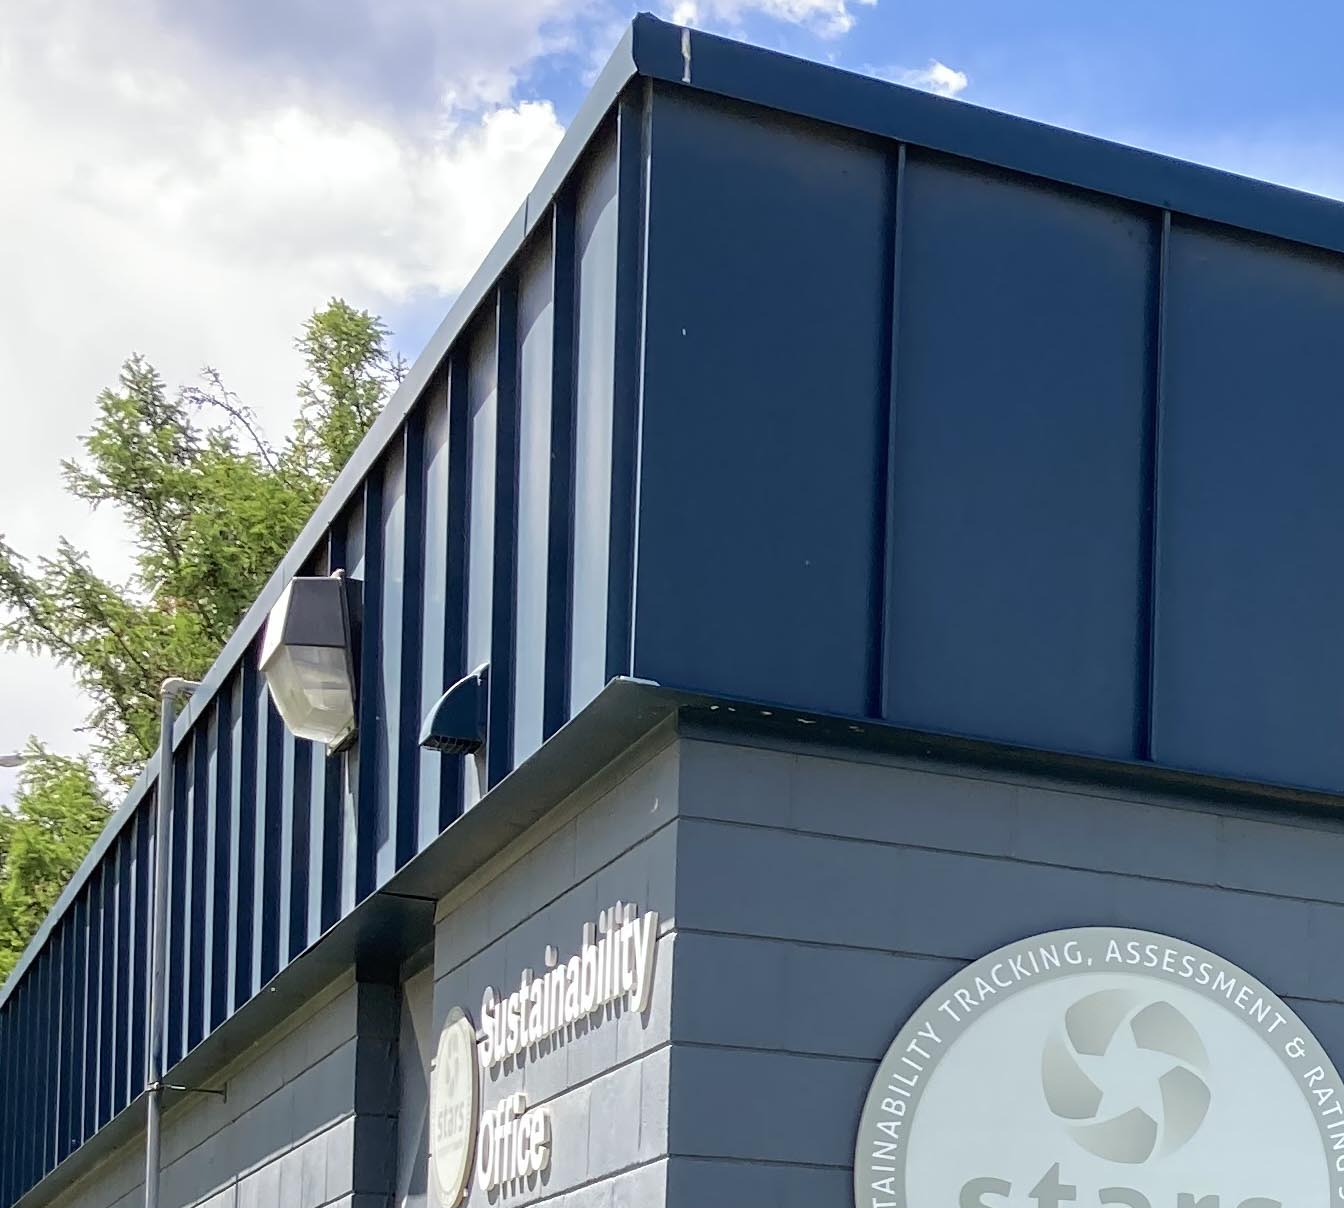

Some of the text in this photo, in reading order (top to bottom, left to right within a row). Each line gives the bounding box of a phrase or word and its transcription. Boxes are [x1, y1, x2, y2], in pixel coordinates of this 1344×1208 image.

[477, 900, 659, 1067] Sustainability
[938, 941, 1093, 1022] TRACKING,
[1105, 940, 1286, 1033] ASSESSMENT
[1285, 1037, 1306, 1058] &
[477, 1092, 550, 1191] Office
